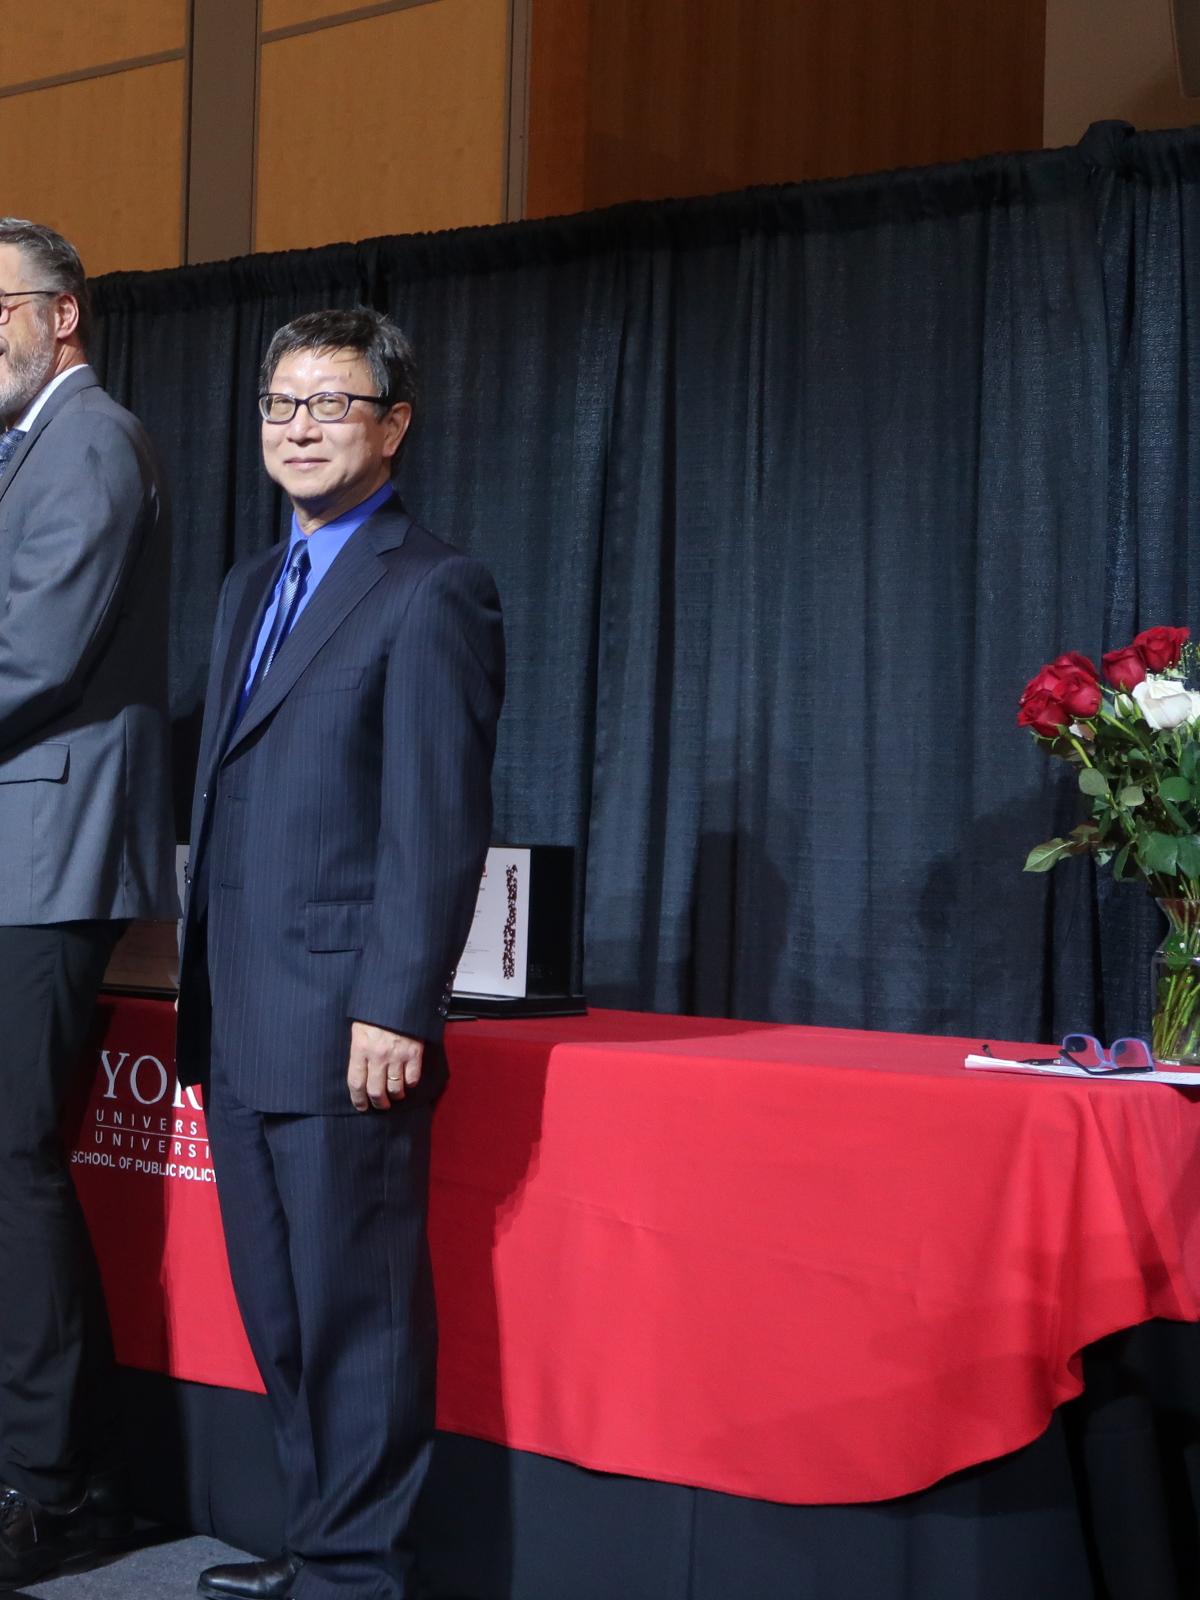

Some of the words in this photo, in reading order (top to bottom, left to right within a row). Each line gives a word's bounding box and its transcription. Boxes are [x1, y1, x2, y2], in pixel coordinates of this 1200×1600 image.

[96, 1109, 198, 1135] UNIVERS
[95, 1131, 210, 1158] UNIVERSI
[71, 1151, 116, 1168] SCHOOL
[119, 1156, 134, 1170] OF
[136, 1159, 176, 1177] PUBLIC
[179, 1166, 216, 1183] POLICY
